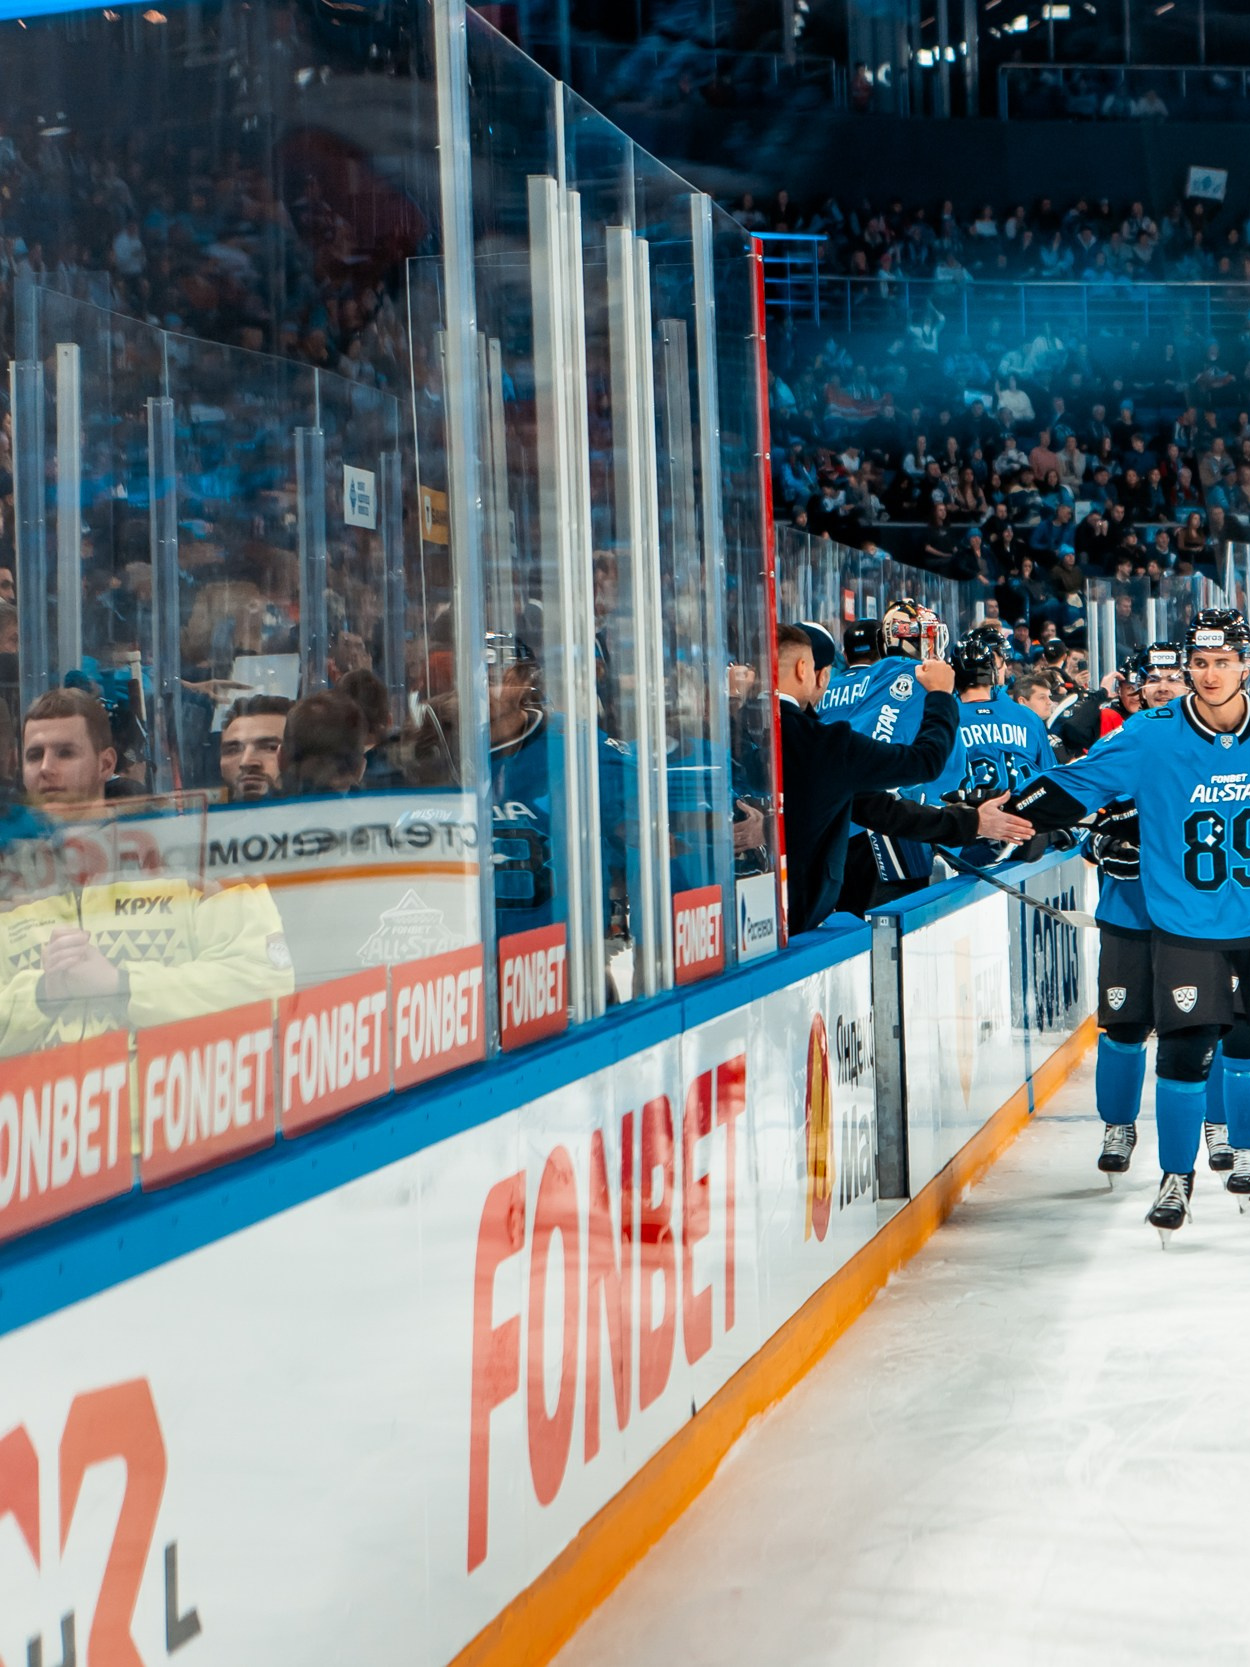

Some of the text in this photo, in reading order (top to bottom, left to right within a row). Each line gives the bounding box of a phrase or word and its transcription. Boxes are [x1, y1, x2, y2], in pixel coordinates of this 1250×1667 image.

[1211, 773, 1248, 784] FONBET
[114, 895, 174, 916] КРУК
[675, 902, 722, 969] FONBET
[396, 965, 483, 1070] FONBET
[502, 944, 566, 1033] FONBET
[143, 1031, 272, 1161] FONBET
[282, 994, 386, 1111] FONBET
[0, 1063, 128, 1206] ONBET
[467, 1052, 746, 1575] FONBET
